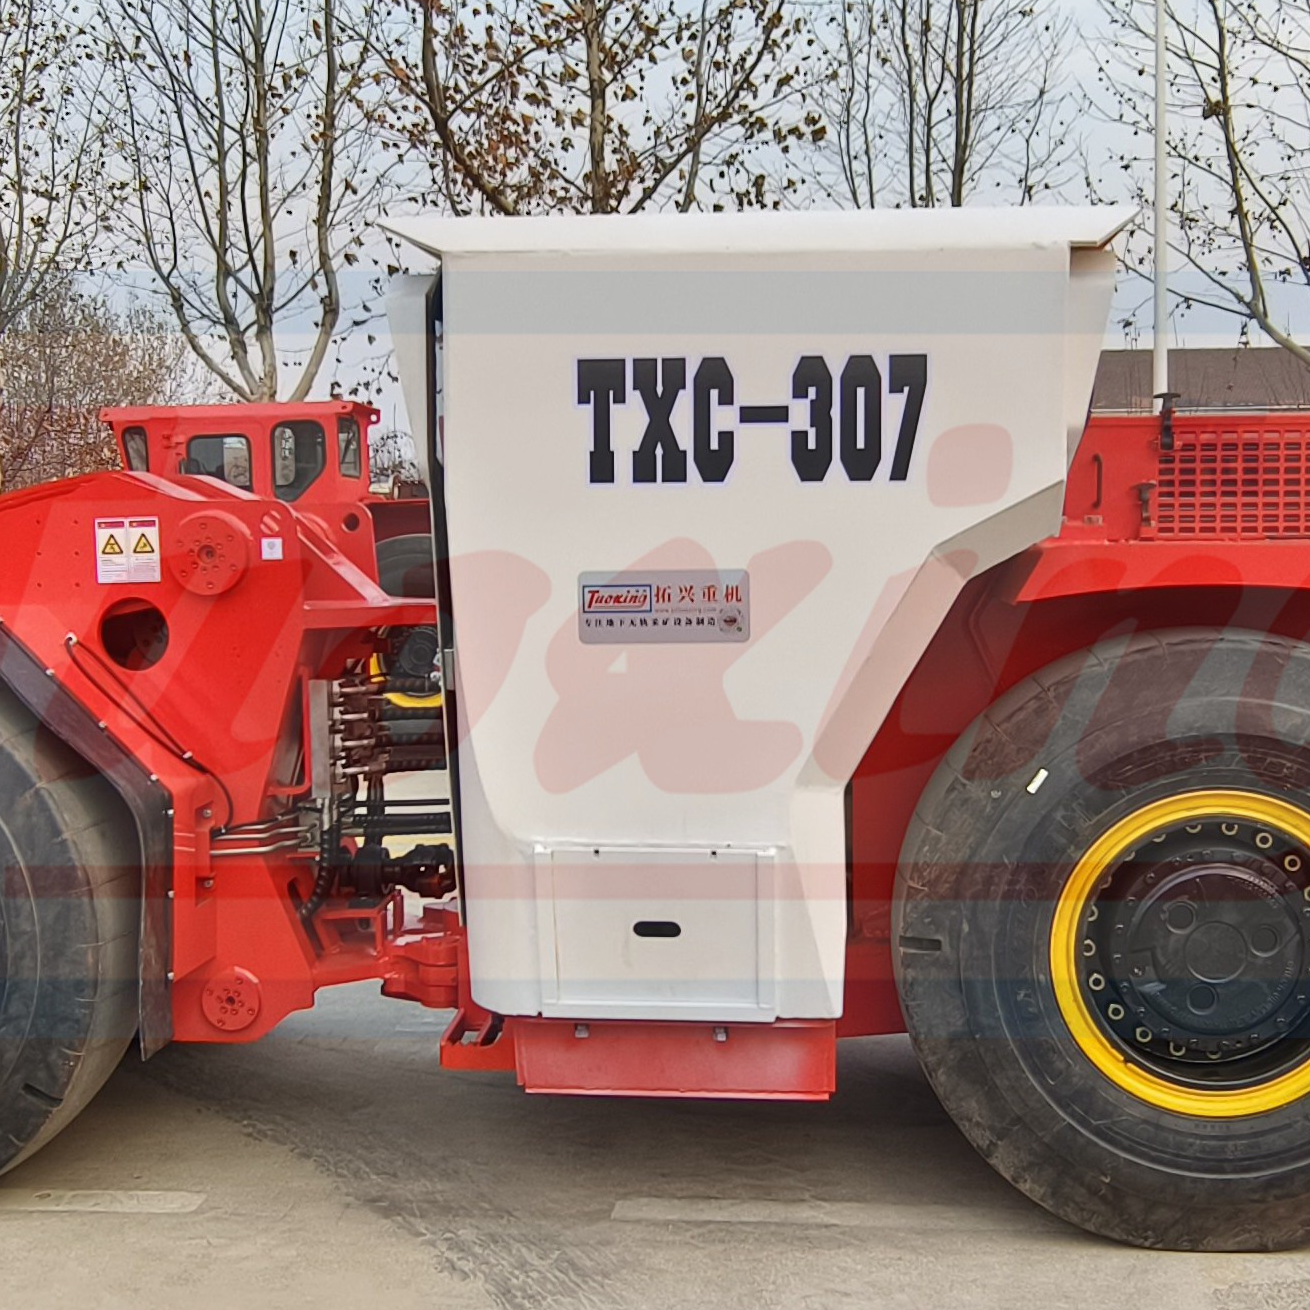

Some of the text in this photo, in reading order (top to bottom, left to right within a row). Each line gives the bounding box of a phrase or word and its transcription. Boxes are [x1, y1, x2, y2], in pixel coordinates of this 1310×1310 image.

[576, 353, 928, 484] TXC-307
[654, 584, 742, 604] 拓兴重机
